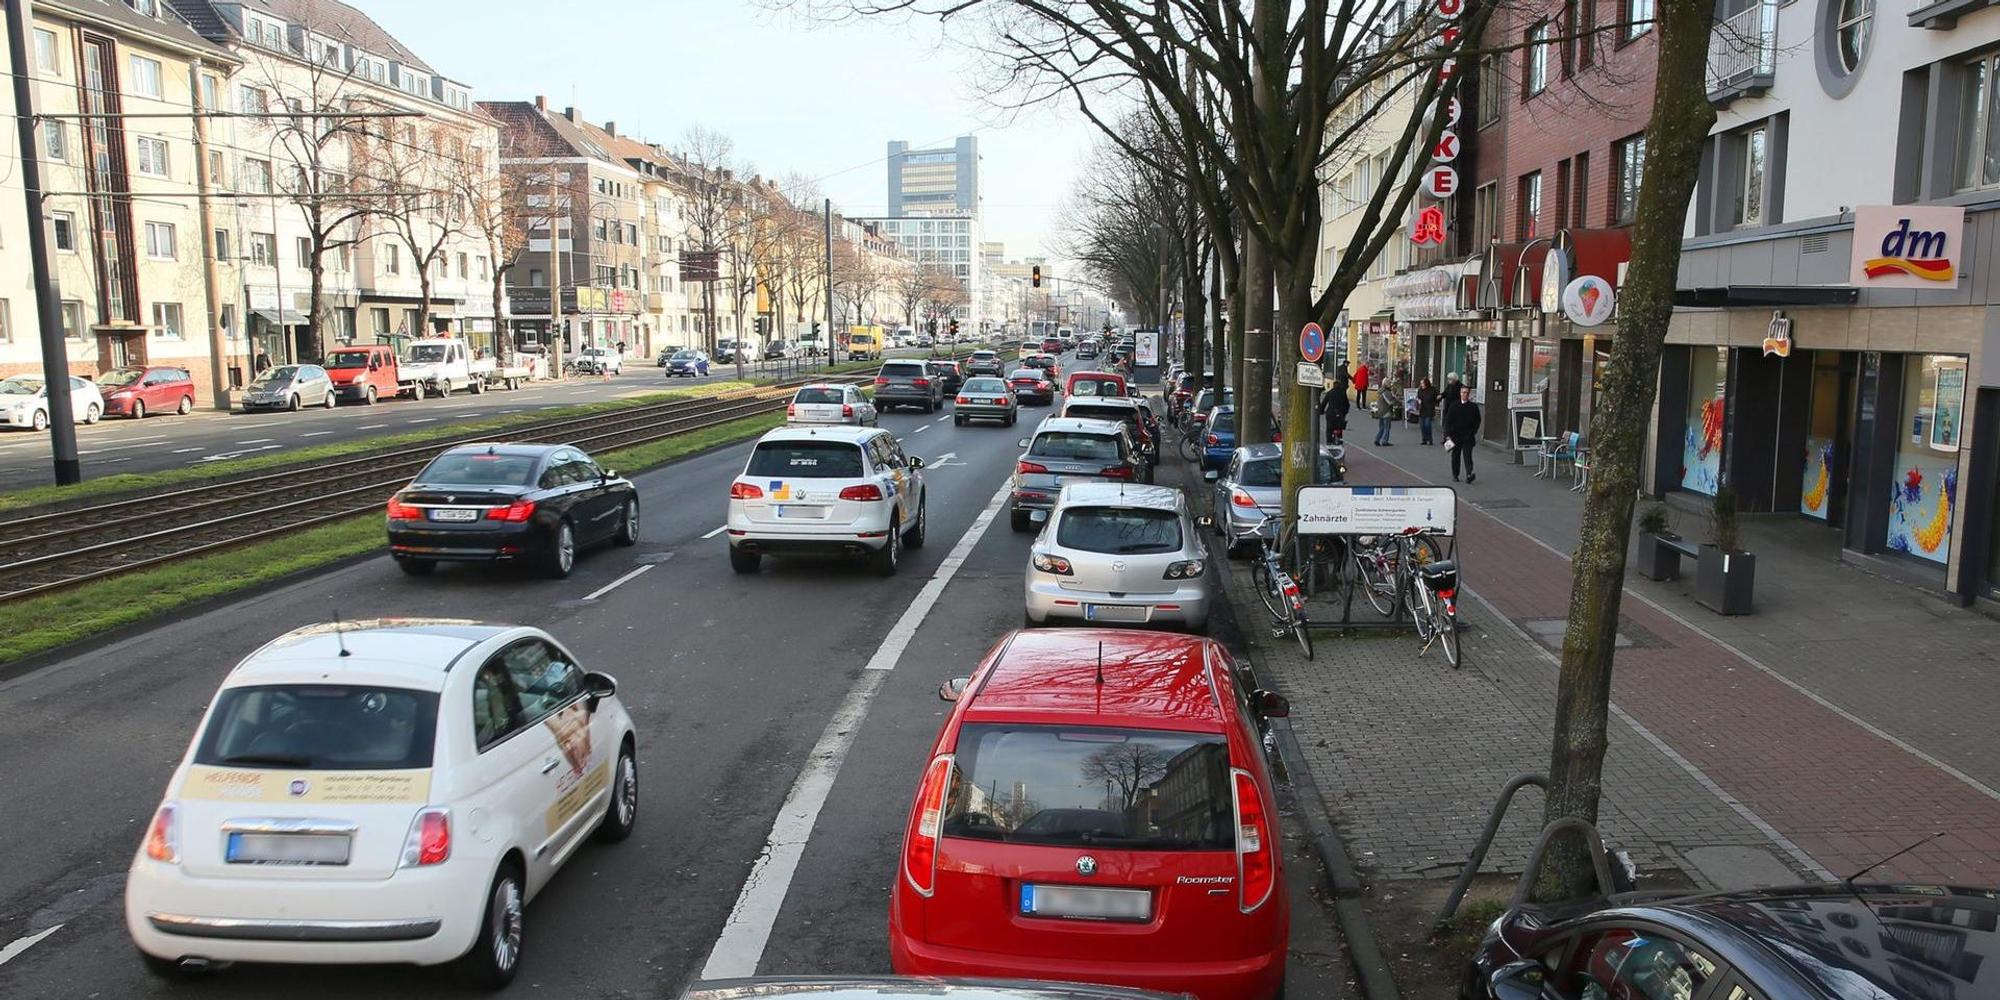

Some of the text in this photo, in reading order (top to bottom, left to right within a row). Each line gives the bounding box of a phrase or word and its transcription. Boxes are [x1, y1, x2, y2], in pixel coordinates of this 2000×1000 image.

[1881, 218, 1948, 258] dm
[1768, 311, 1790, 341] dm
[1176, 875, 1235, 885] Roomster
